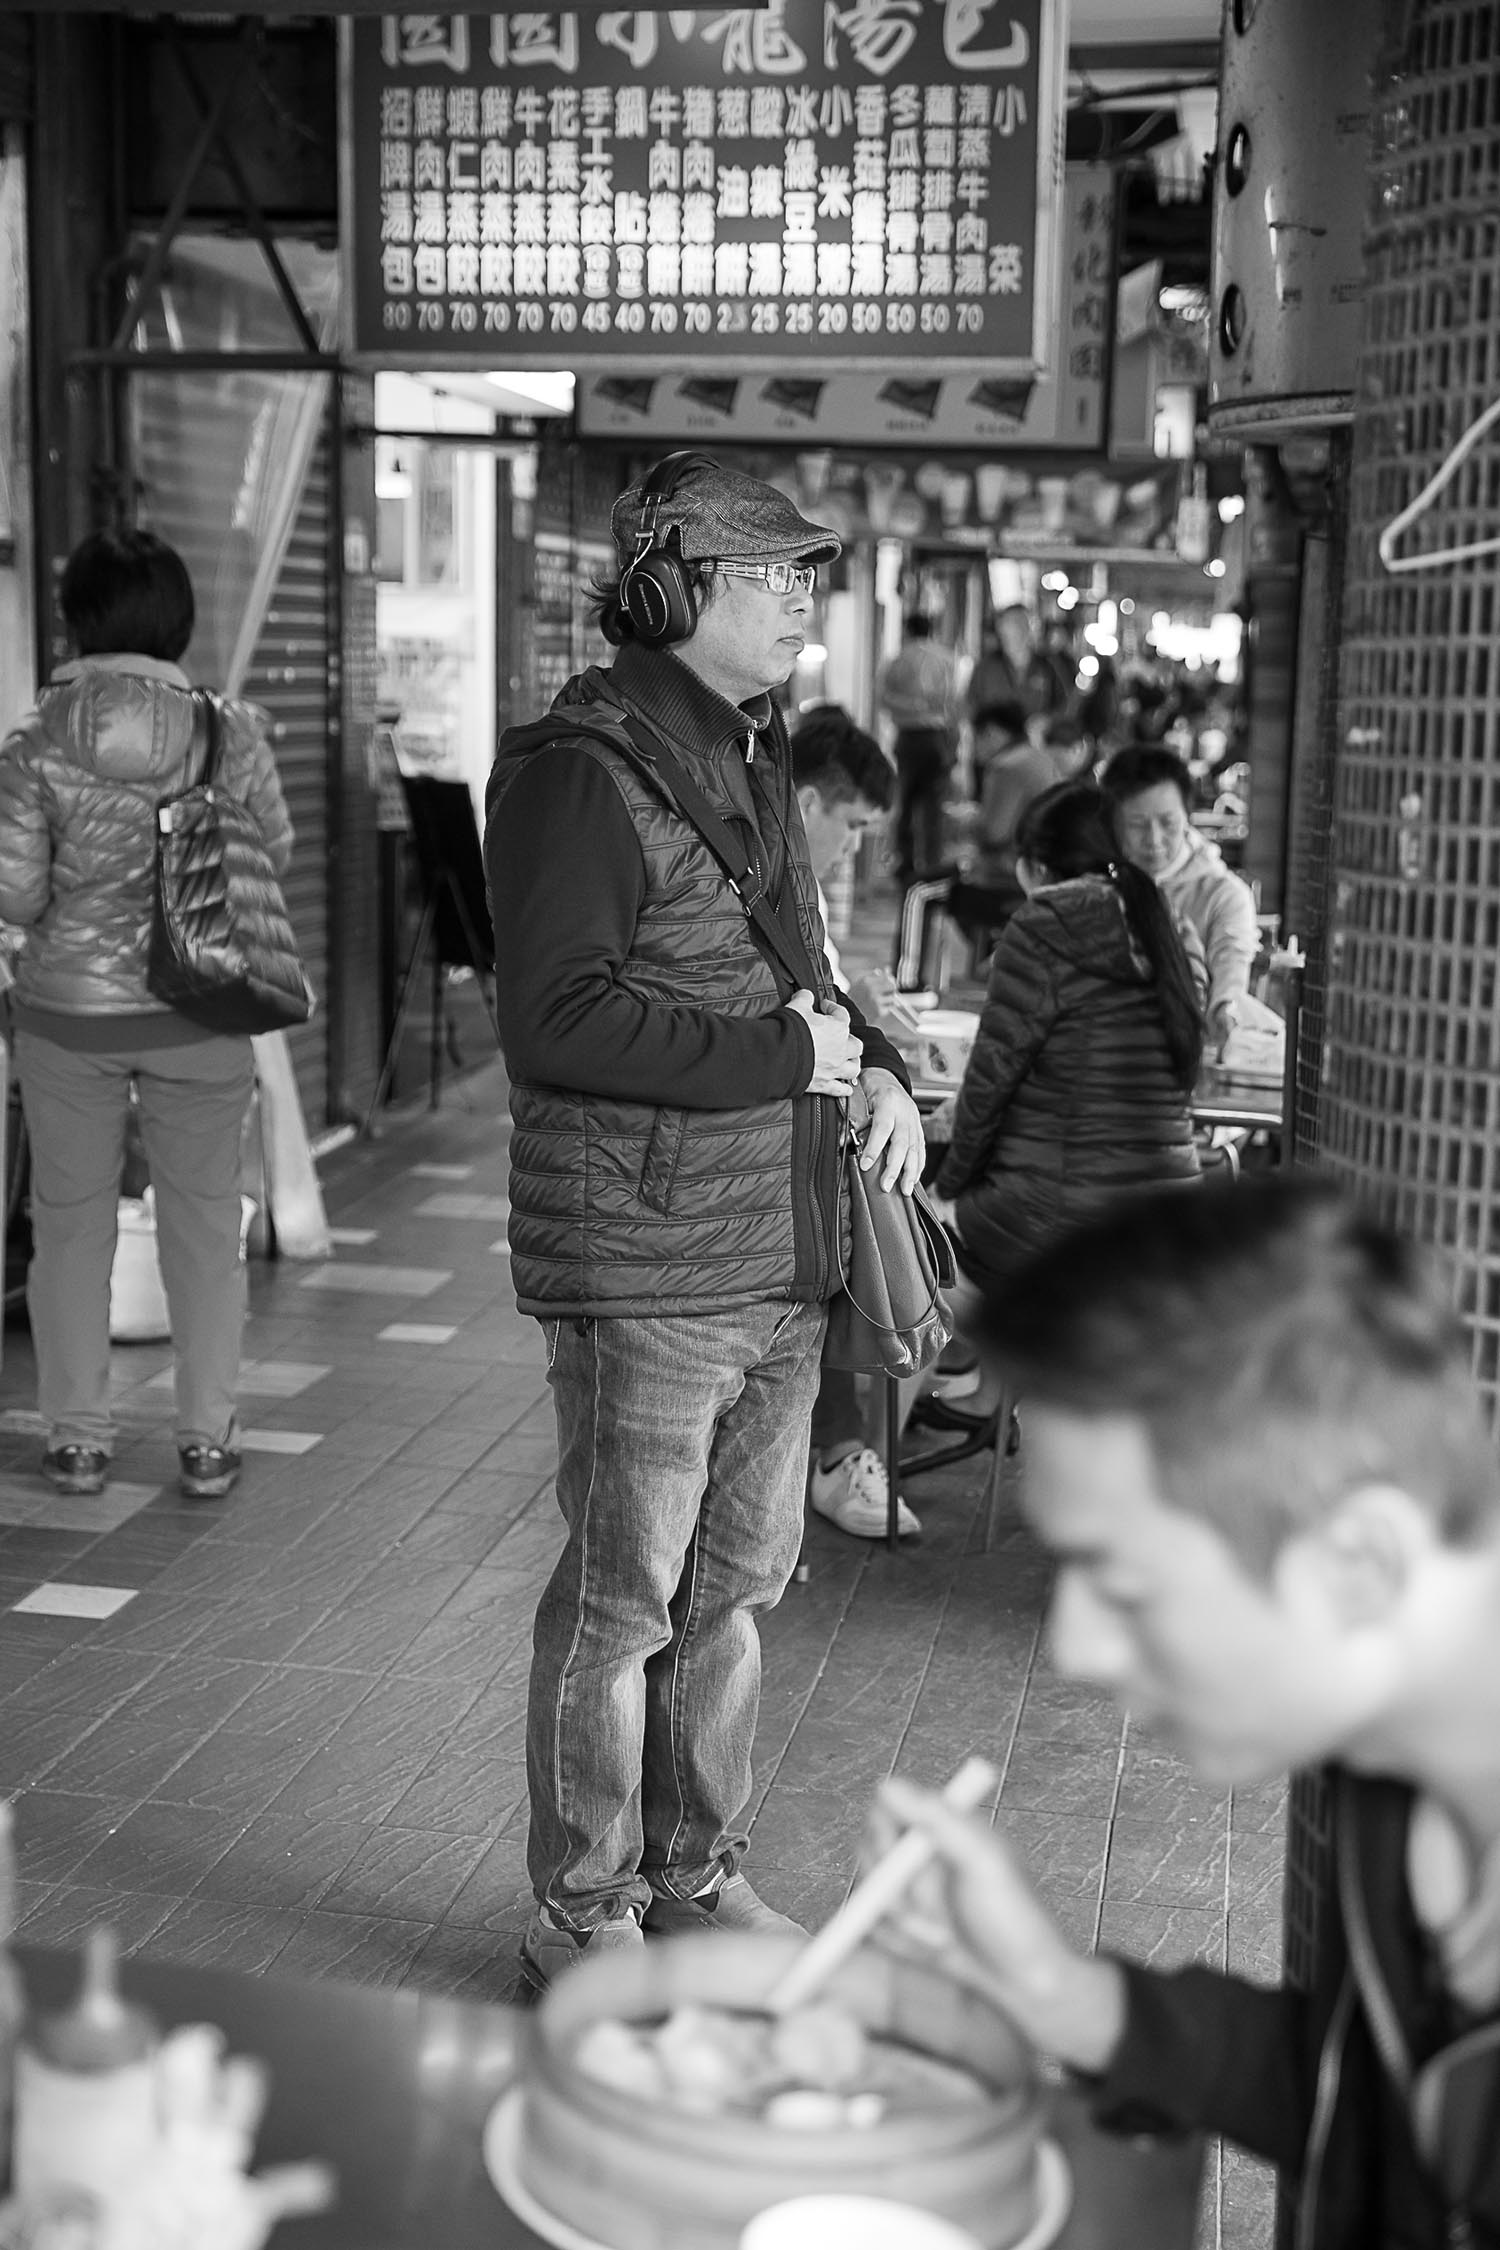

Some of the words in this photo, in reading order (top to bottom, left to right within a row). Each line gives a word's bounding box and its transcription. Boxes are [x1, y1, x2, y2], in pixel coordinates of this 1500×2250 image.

[382, 302, 411, 332] 80
[416, 302, 444, 332] 70
[449, 302, 477, 332] 70
[482, 302, 511, 333] 70
[515, 302, 544, 333] 70
[549, 302, 578, 333] 70
[581, 302, 611, 333] 45
[614, 302, 646, 333] 40
[648, 302, 679, 333] 70
[682, 302, 712, 333] 70
[750, 302, 780, 334] 25
[784, 302, 813, 334] 25
[817, 302, 848, 334] 20
[852, 302, 882, 334] 50
[886, 302, 916, 334] 50
[920, 302, 950, 333] 50
[956, 302, 984, 333] 70
